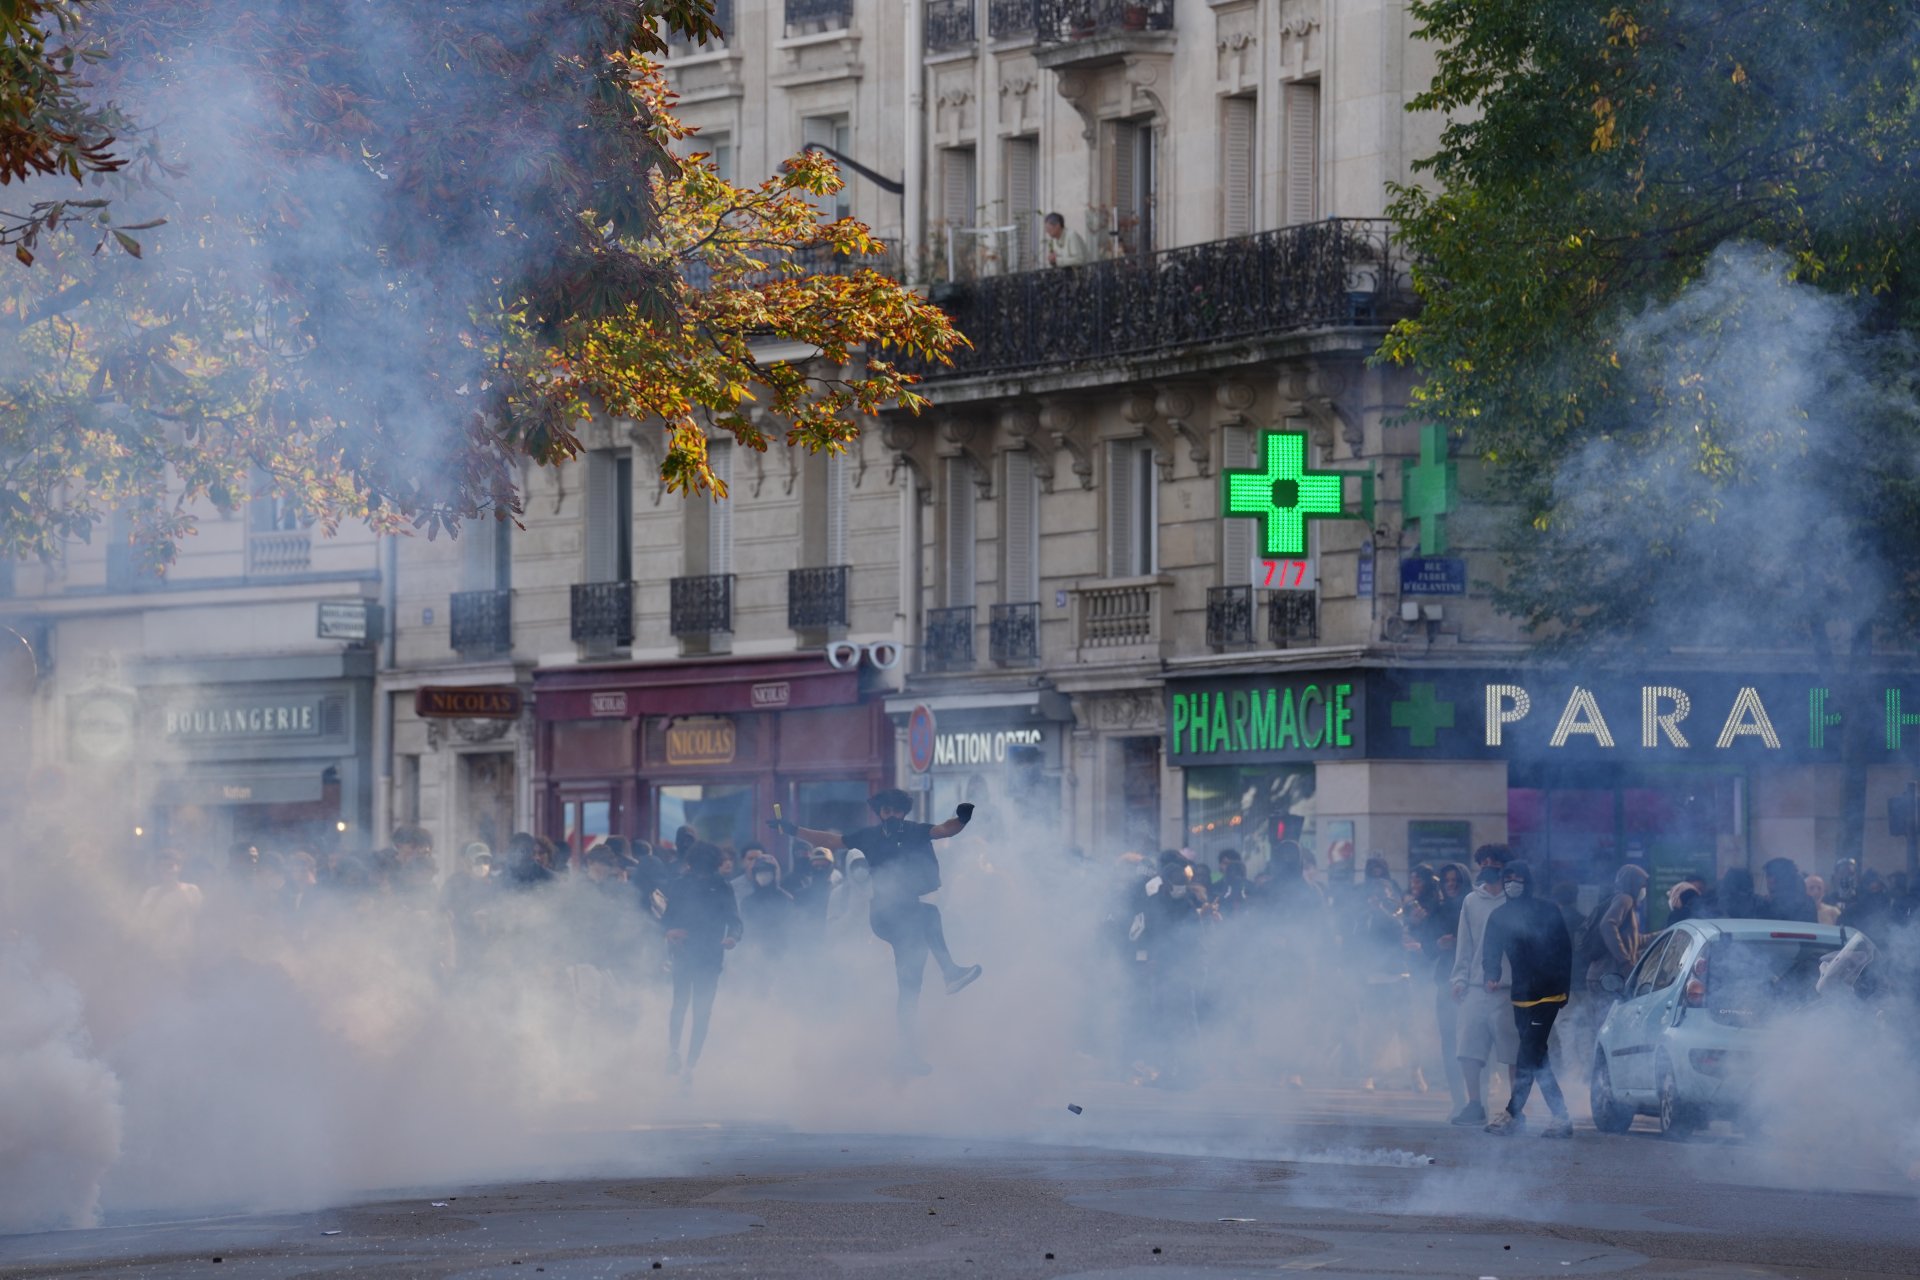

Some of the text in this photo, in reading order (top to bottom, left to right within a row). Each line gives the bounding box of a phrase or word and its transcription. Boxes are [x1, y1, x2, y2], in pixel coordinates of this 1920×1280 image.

[1263, 560, 1306, 587] 7/7
[432, 693, 512, 711] NICOLAS
[592, 697, 626, 711] NICOLAS
[753, 683, 789, 703] NICOLAS
[167, 706, 312, 735] BOULANGERIE
[1173, 684, 1351, 754] PHARMACIE
[671, 729, 732, 755] NICOLAS
[934, 732, 992, 765] NATION
